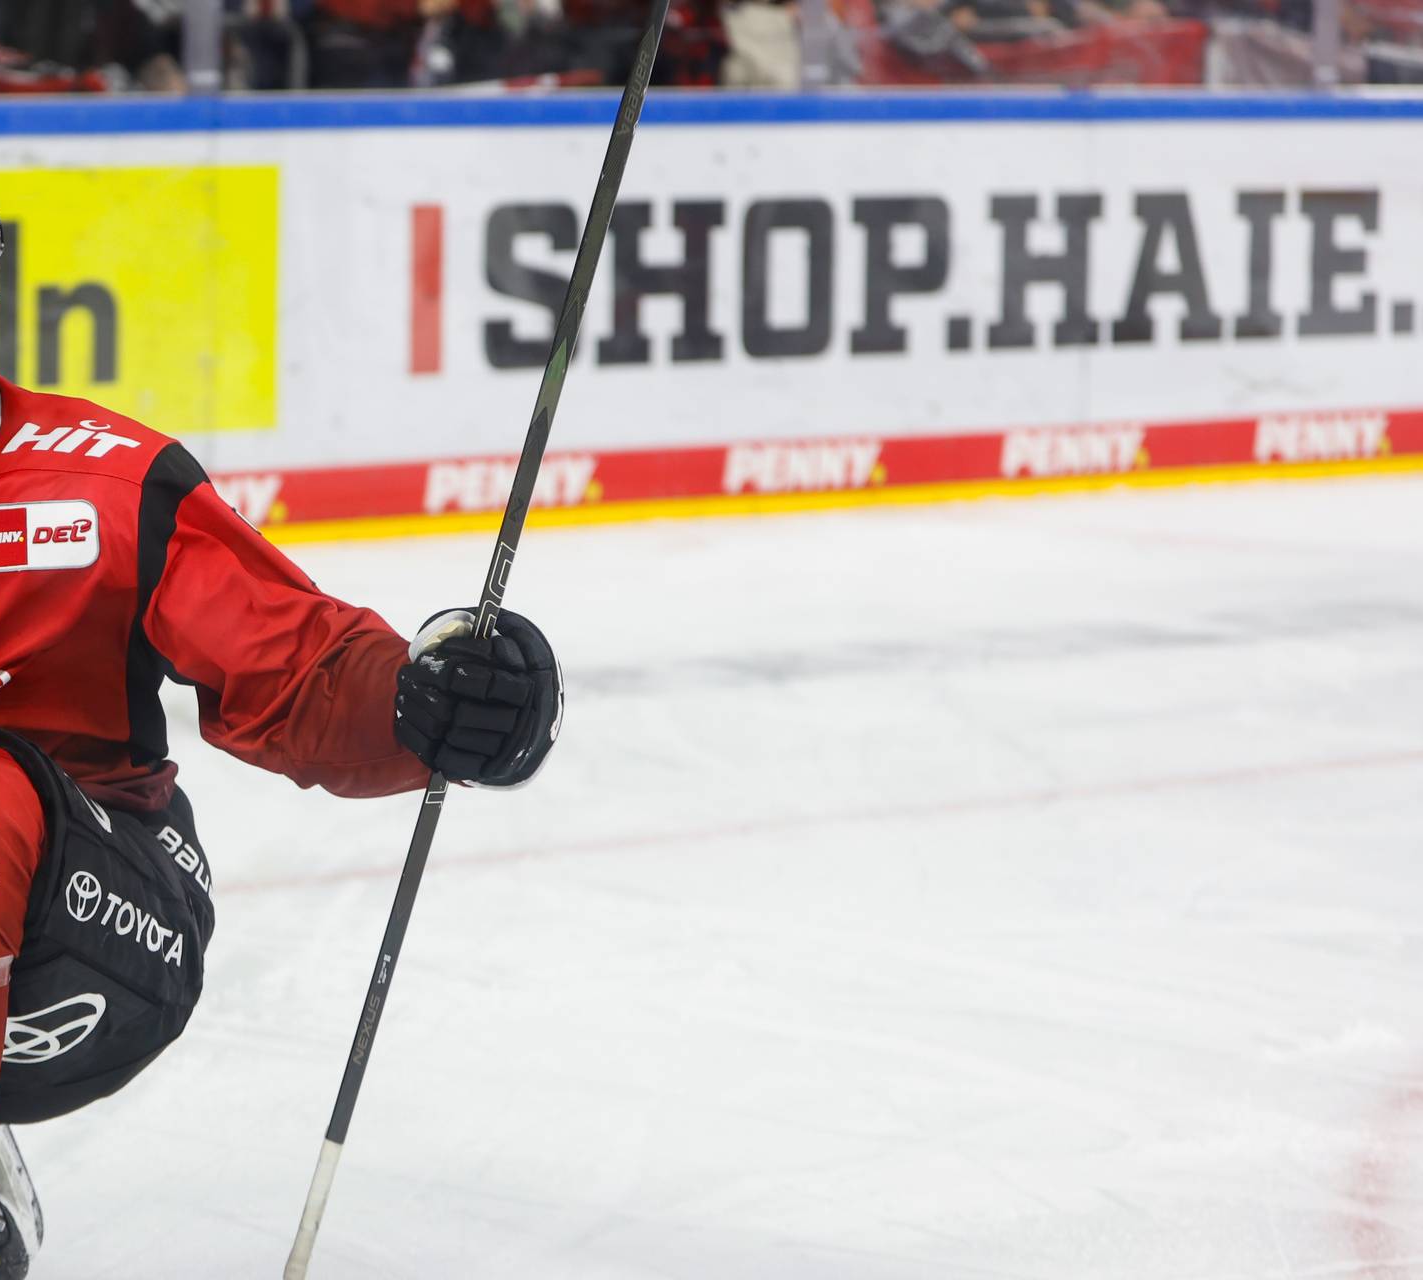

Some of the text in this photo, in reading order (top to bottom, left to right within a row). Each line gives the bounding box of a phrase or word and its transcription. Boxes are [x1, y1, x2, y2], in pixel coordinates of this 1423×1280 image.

[32, 518, 92, 545] DEL
[156, 825, 214, 899] BAU
[101, 892, 184, 967] TOYOTA
[352, 992, 381, 1066] NEXUS
